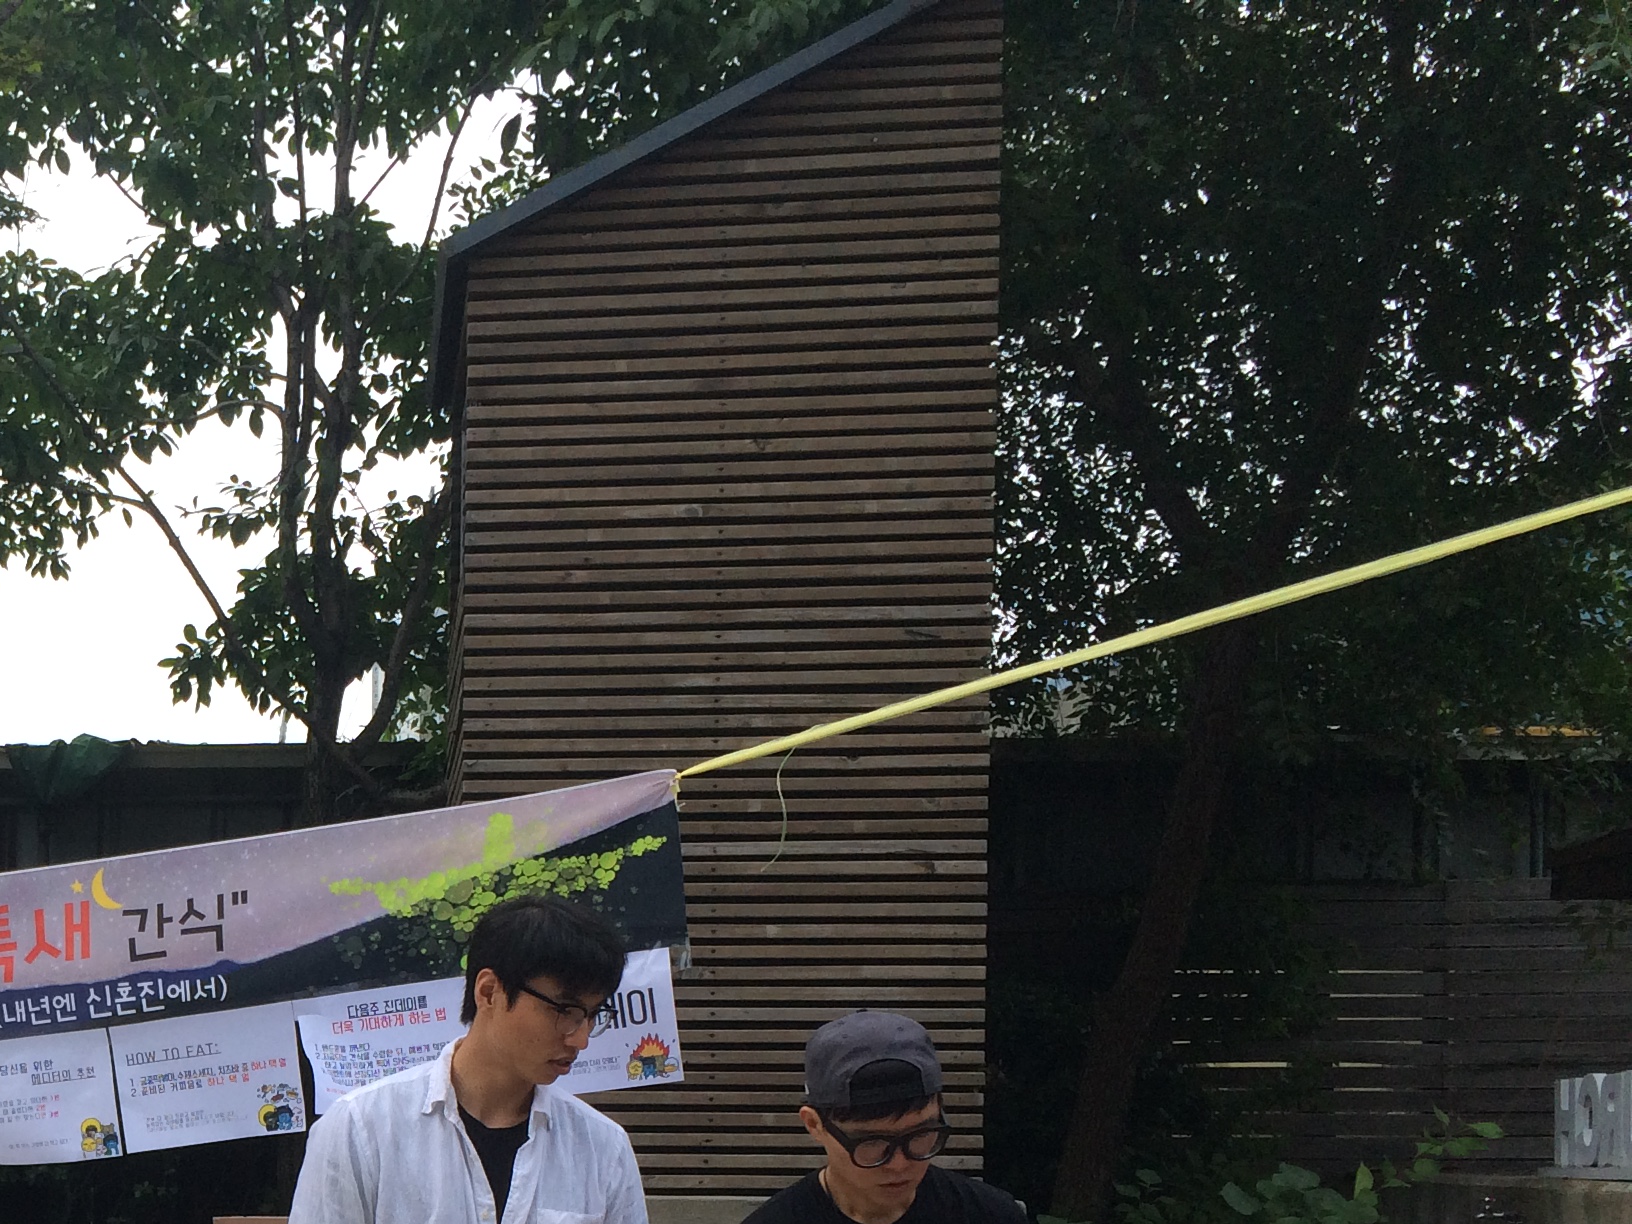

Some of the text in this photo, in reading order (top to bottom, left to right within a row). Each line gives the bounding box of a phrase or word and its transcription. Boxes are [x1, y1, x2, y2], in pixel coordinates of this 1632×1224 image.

[122, 889, 248, 962] 간식"
[86, 974, 229, 1019] 신혼진에서)
[347, 995, 428, 1019] 다음주 진데이를
[332, 1008, 447, 1035] 더욱 기대하게 하는 법
[0, 1062, 28, 1077] 당신을
[33, 1059, 54, 1072] 위한
[126, 1051, 156, 1067] HOW
[162, 1048, 181, 1062] TO
[251, 1059, 266, 1071] 하나
[207, 1076, 225, 1086] 하나
